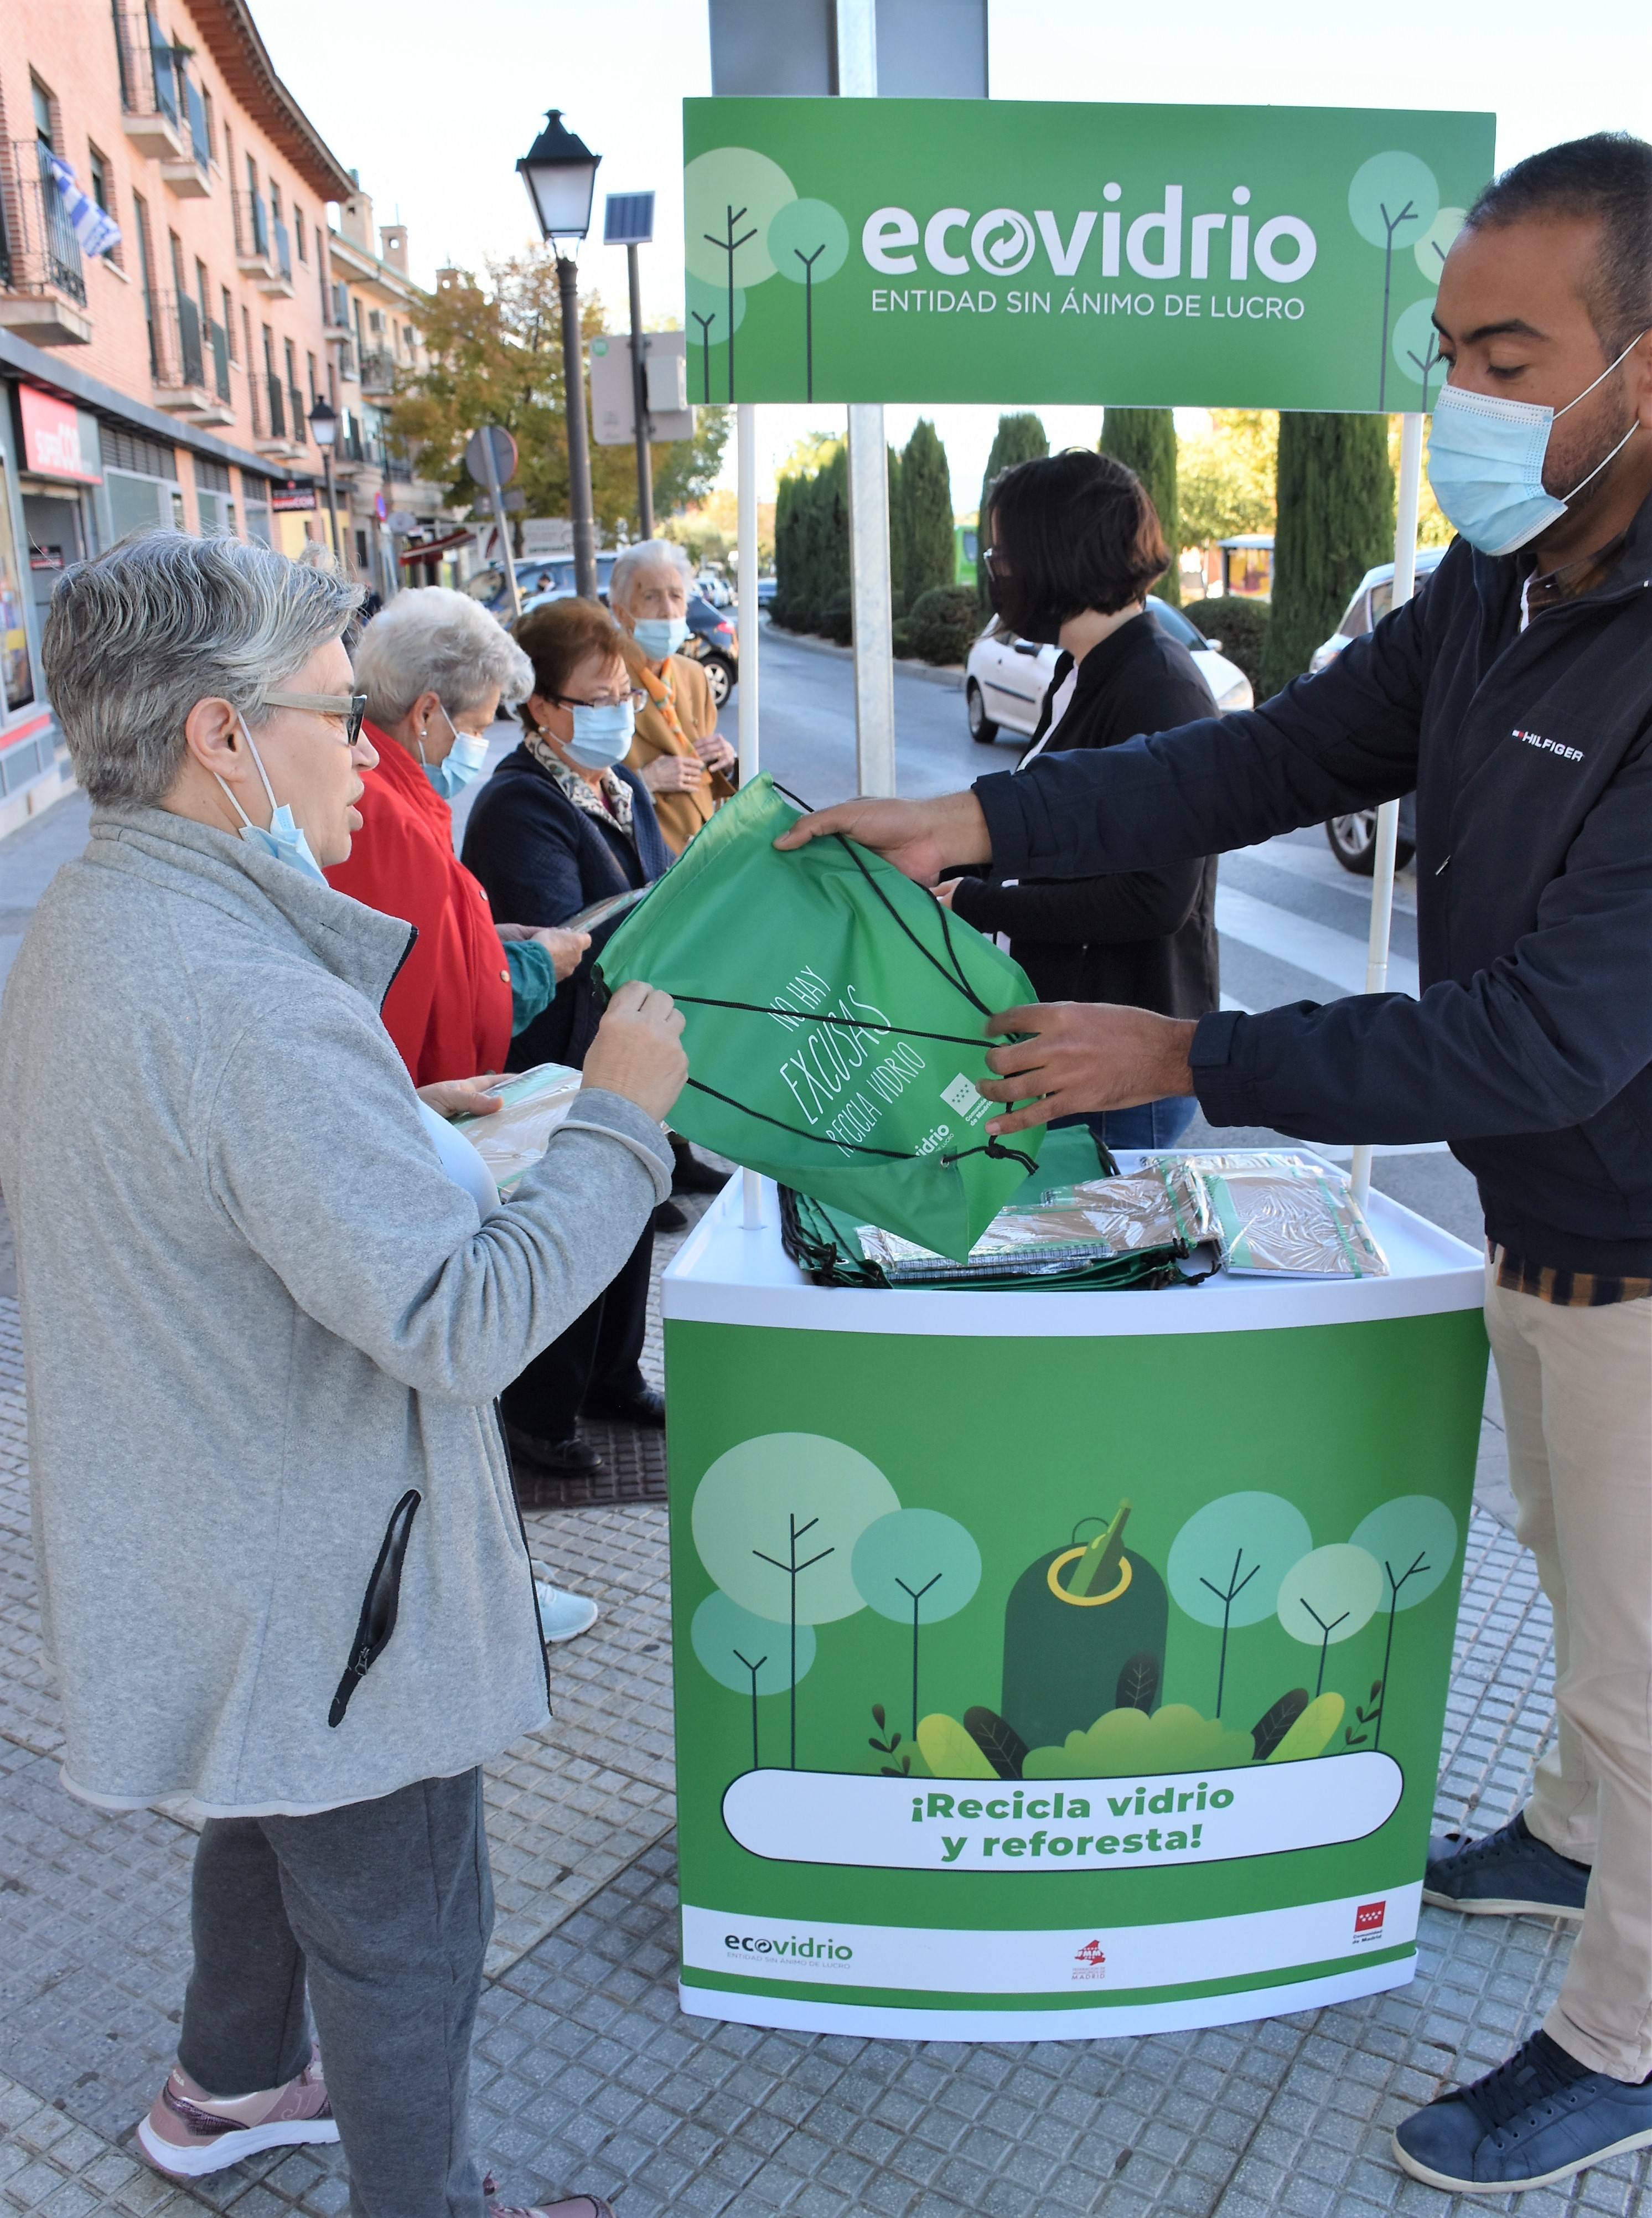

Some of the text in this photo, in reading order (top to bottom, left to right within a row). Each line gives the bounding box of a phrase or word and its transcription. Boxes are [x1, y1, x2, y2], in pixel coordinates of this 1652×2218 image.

[862, 182, 1317, 283] ecovidrio
[872, 287, 1305, 320] ENTIDAD SIN ÁNIMO DE LUCRO
[1522, 731, 1584, 762] HILFIGER
[767, 965, 831, 1032] NO HAY
[779, 984, 891, 1125] EXCUSAS
[826, 1041, 926, 1158] RECICLA VIDRIO
[965, 1098, 987, 1121] Comunida
[912, 1782, 1235, 1822] ¡Recicla vidrio
[941, 1823, 1203, 1862] y reforesta!
[724, 1935, 853, 1961] ecovidrio
[727, 1952, 763, 1962] ENTIDAD
